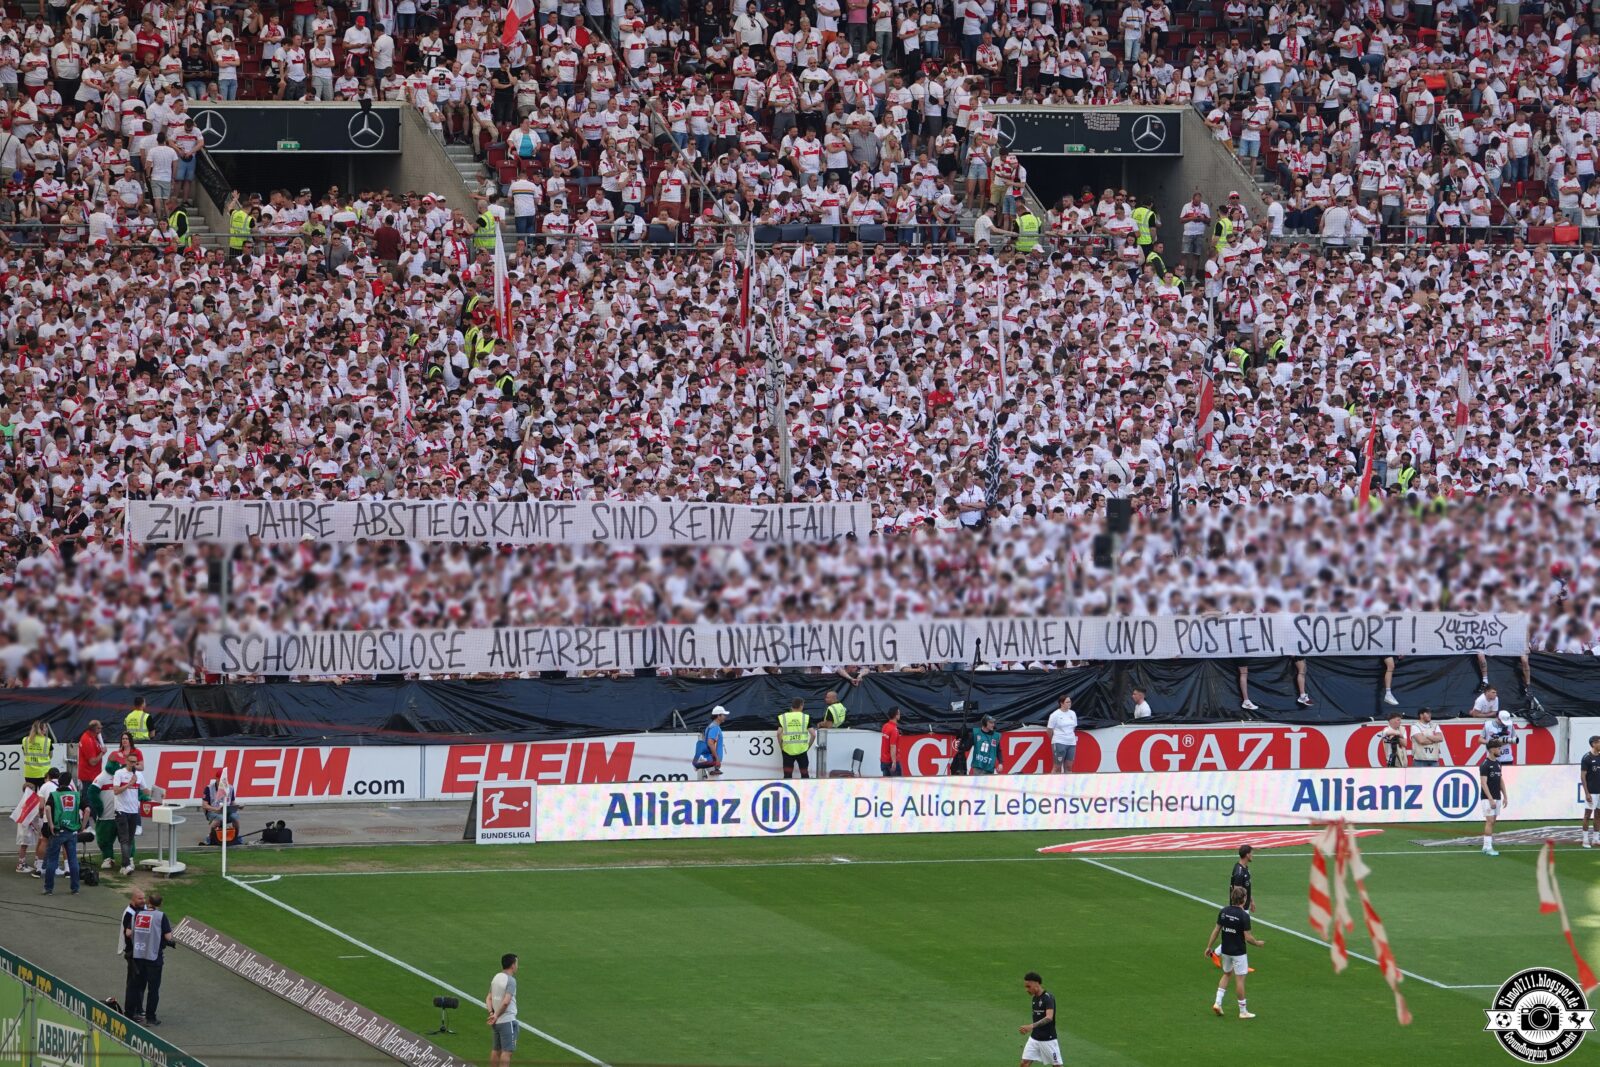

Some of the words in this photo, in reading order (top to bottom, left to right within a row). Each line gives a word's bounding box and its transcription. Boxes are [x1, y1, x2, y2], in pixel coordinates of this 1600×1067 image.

[147, 503, 223, 540] ZWEI
[246, 503, 335, 539] JAHRE
[353, 502, 576, 539] ABSTIEGSKAMPF
[592, 505, 658, 540] SIND
[669, 505, 735, 542] KEIN
[220, 631, 466, 673] SCHONUNGSLOSE
[716, 622, 898, 668] UNABHÄNGIG
[919, 623, 965, 660] VON
[985, 619, 1083, 660] NAMEN
[1105, 619, 1158, 655] UND
[1175, 616, 1284, 656] POSTEN,
[1446, 619, 1498, 635] ULTRAS
[749, 737, 774, 756] 33
[604, 791, 741, 827] Allianz
[854, 796, 893, 819] Die
[901, 794, 986, 818] Allianz
[994, 789, 1236, 816] Lebensversicherung
[1292, 777, 1423, 812] Allianz
